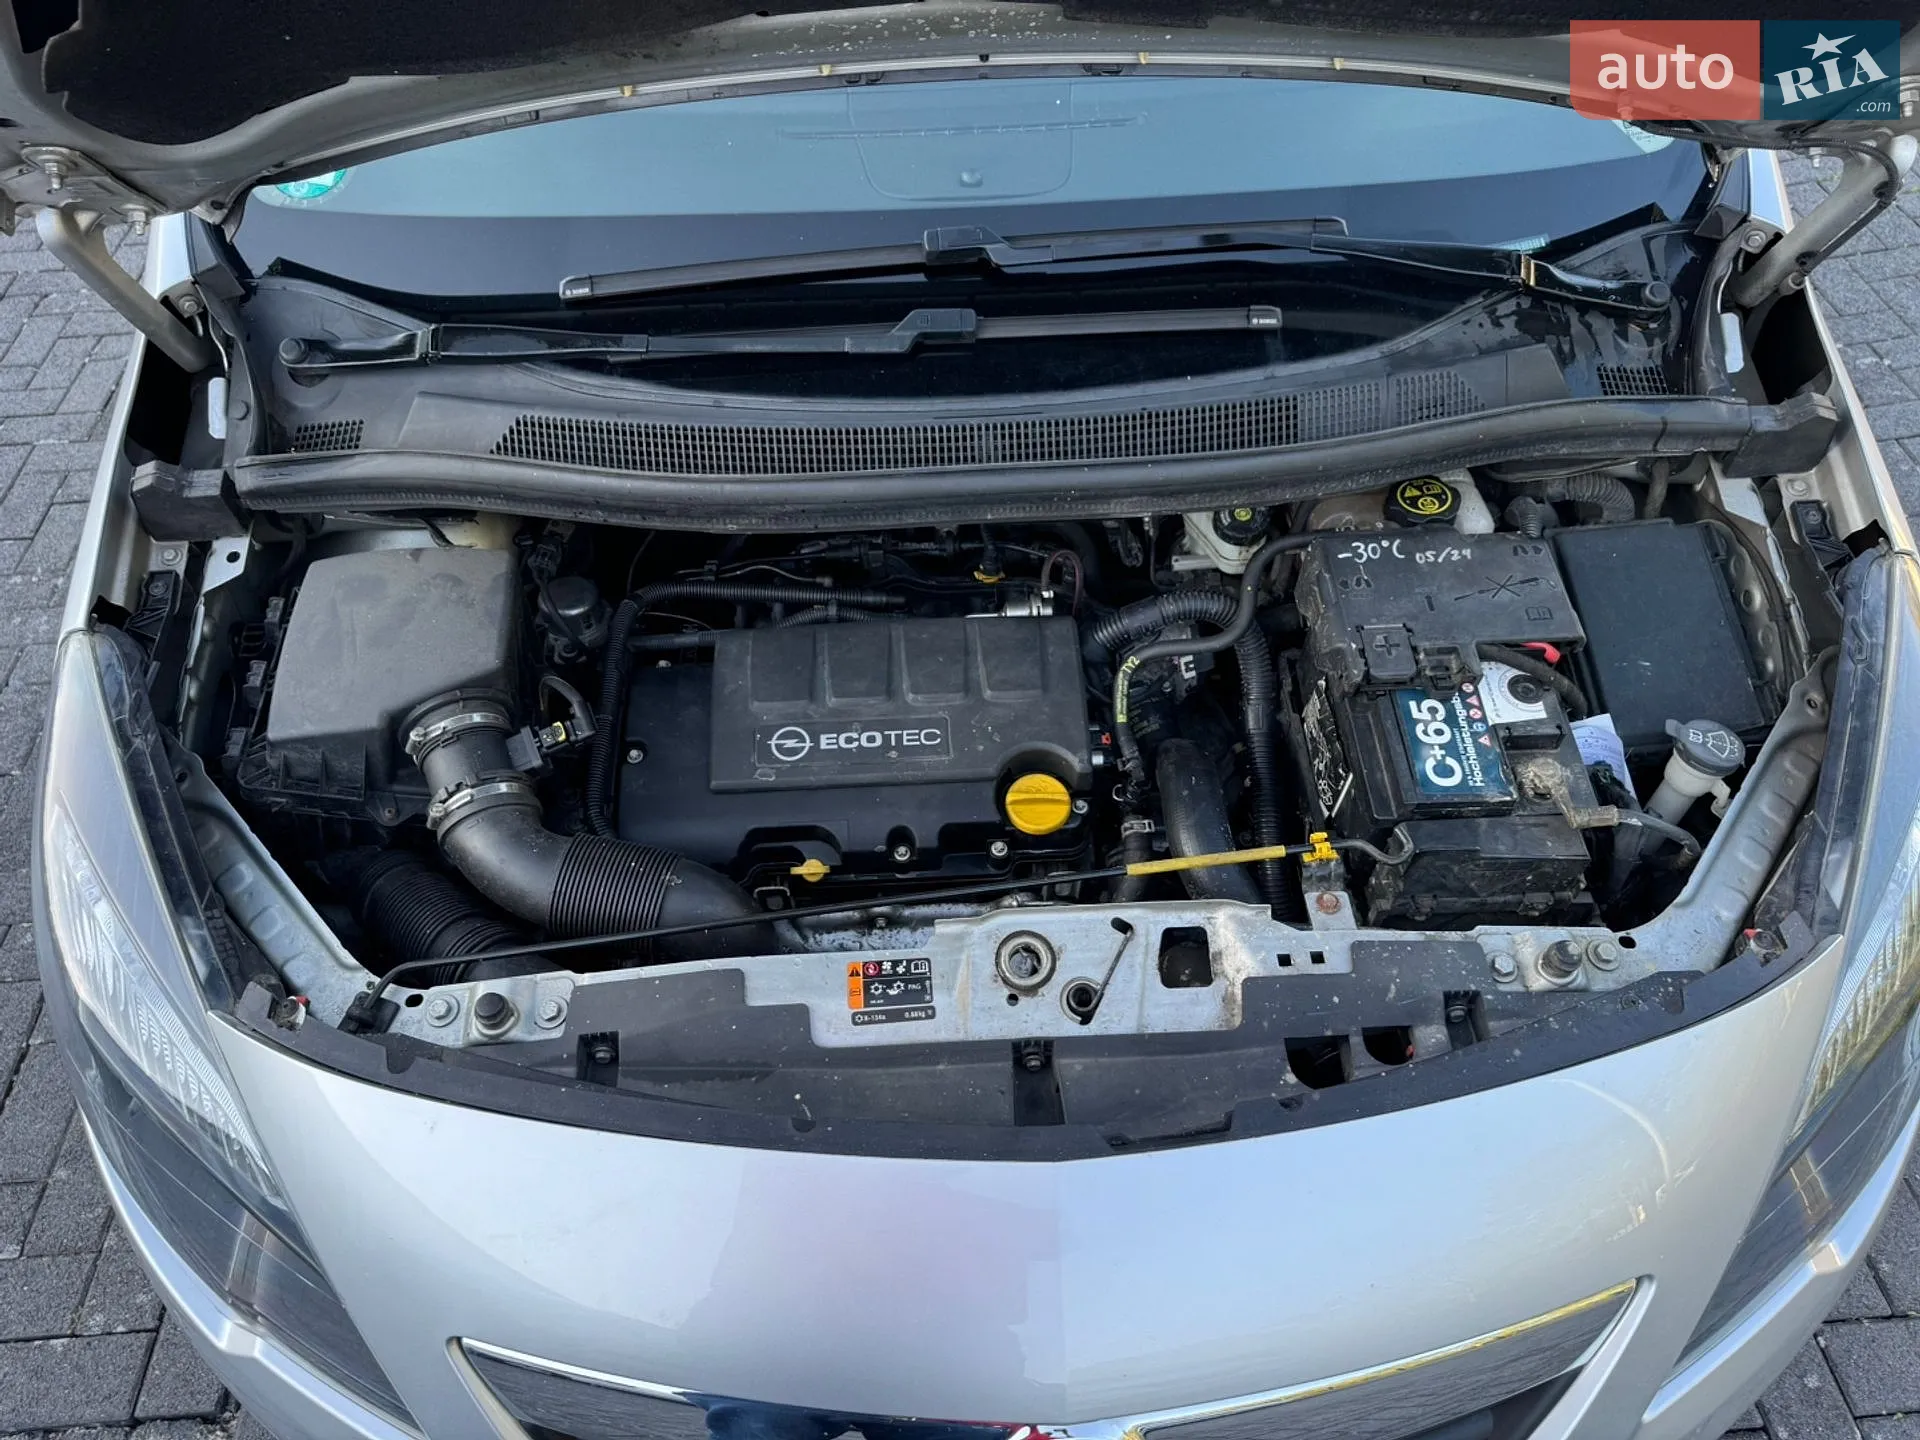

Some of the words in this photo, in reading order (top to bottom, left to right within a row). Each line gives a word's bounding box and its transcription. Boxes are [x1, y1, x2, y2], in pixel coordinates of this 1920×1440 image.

[1415, 547, 1472, 564] 05/24
[819, 728, 942, 750] ECOTEC
[1408, 698, 1463, 788] C+65
